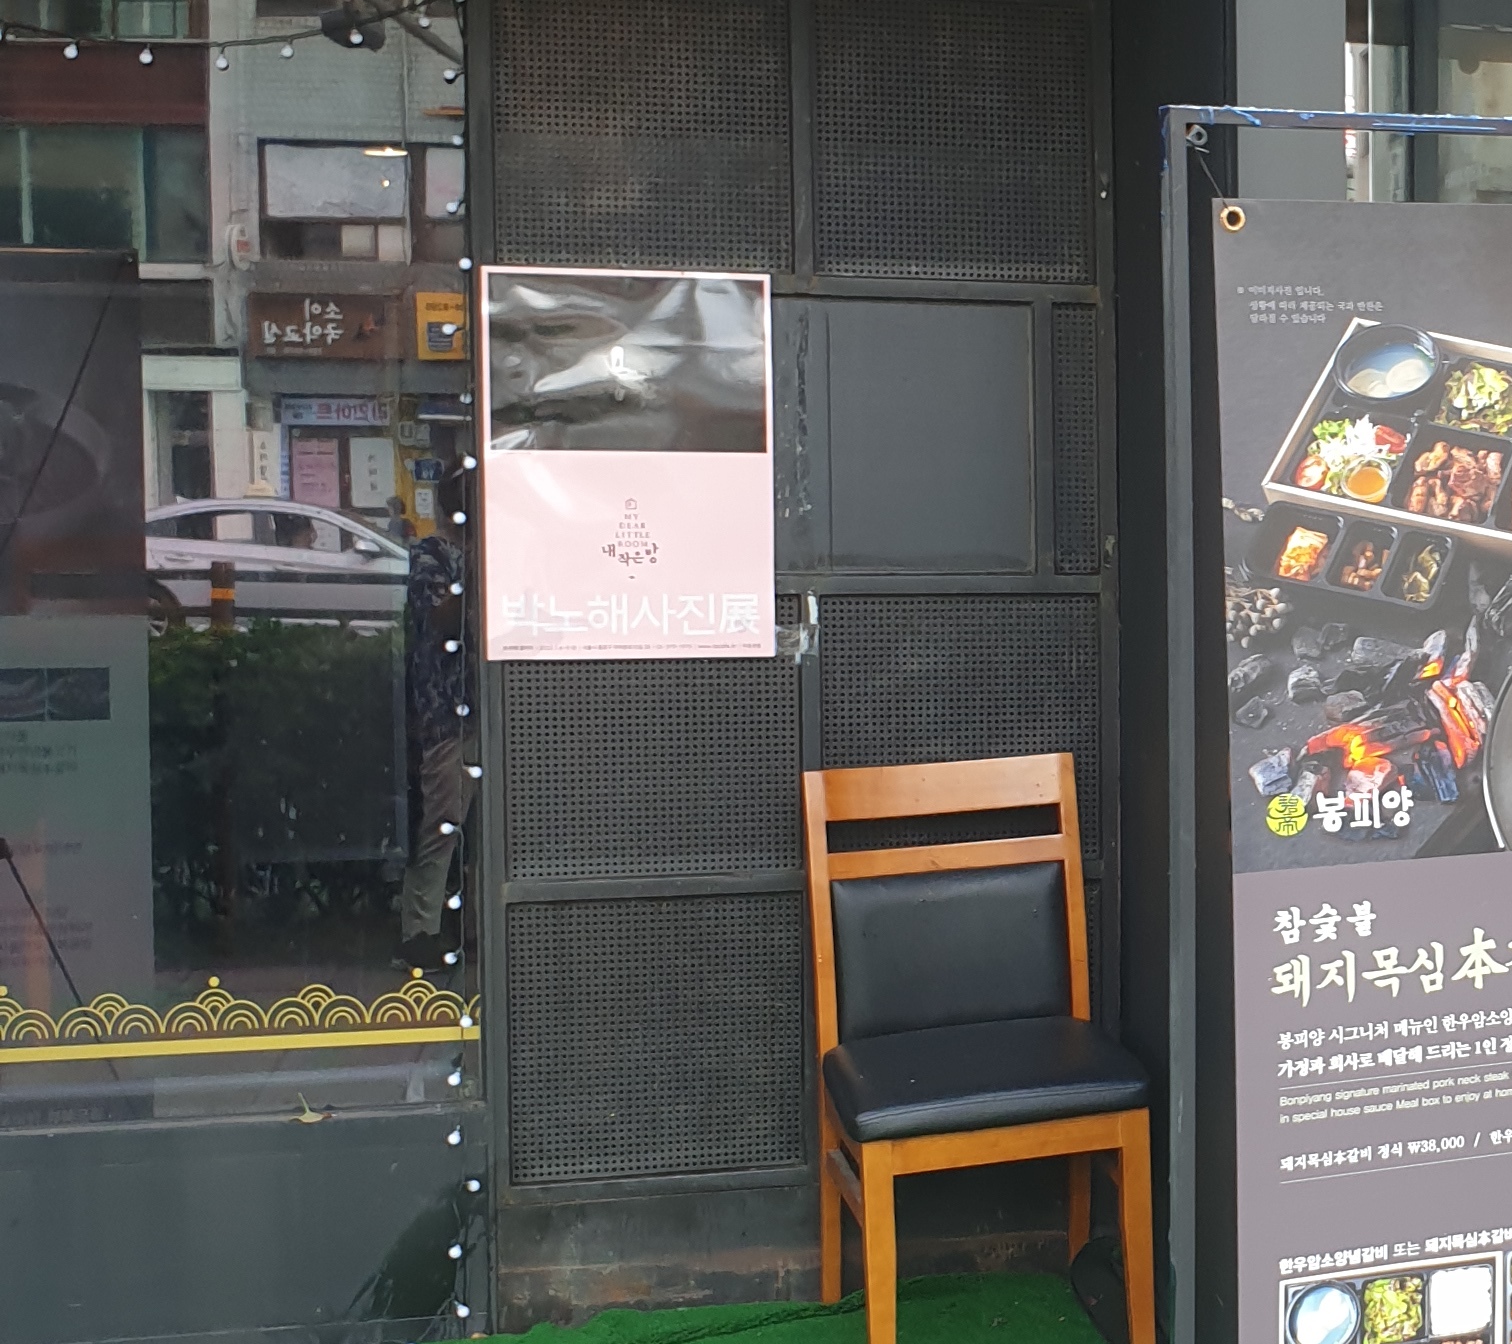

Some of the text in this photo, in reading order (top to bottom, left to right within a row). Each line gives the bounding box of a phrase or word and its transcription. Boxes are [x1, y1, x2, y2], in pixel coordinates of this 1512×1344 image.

[602, 544, 616, 557] 내
[615, 531, 650, 539] LITTLE
[502, 593, 761, 636] 박노해사진展
[1312, 788, 1414, 833] 봉피양
[1277, 1029, 1325, 1050] 봉피양
[1328, 1021, 1388, 1044] 시그니처
[1393, 1016, 1438, 1037] 메뉴인
[1277, 1057, 1326, 1078] 가정과
[1328, 1052, 1375, 1073] 회사로
[1425, 1041, 1472, 1060] 드리는
[1474, 1037, 1498, 1056] 1인
[1335, 1087, 1380, 1102] signature
[1382, 1080, 1430, 1095] marinated
[1432, 1077, 1455, 1089] pork
[1457, 1073, 1481, 1085] neck
[1483, 1071, 1510, 1083] steak
[1280, 1113, 1290, 1124] in
[1291, 1109, 1328, 1123] special
[1330, 1105, 1361, 1118] house
[1363, 1102, 1393, 1113] sauce
[1395, 1097, 1420, 1110] Meal
[1421, 1094, 1441, 1106] box
[1442, 1093, 1453, 1104] to
[1454, 1090, 1481, 1103] enjoy
[1377, 1142, 1403, 1159] 정식
[1278, 1244, 1389, 1275] 한우암소양념갈비
[1393, 1241, 1421, 1257] 또는
